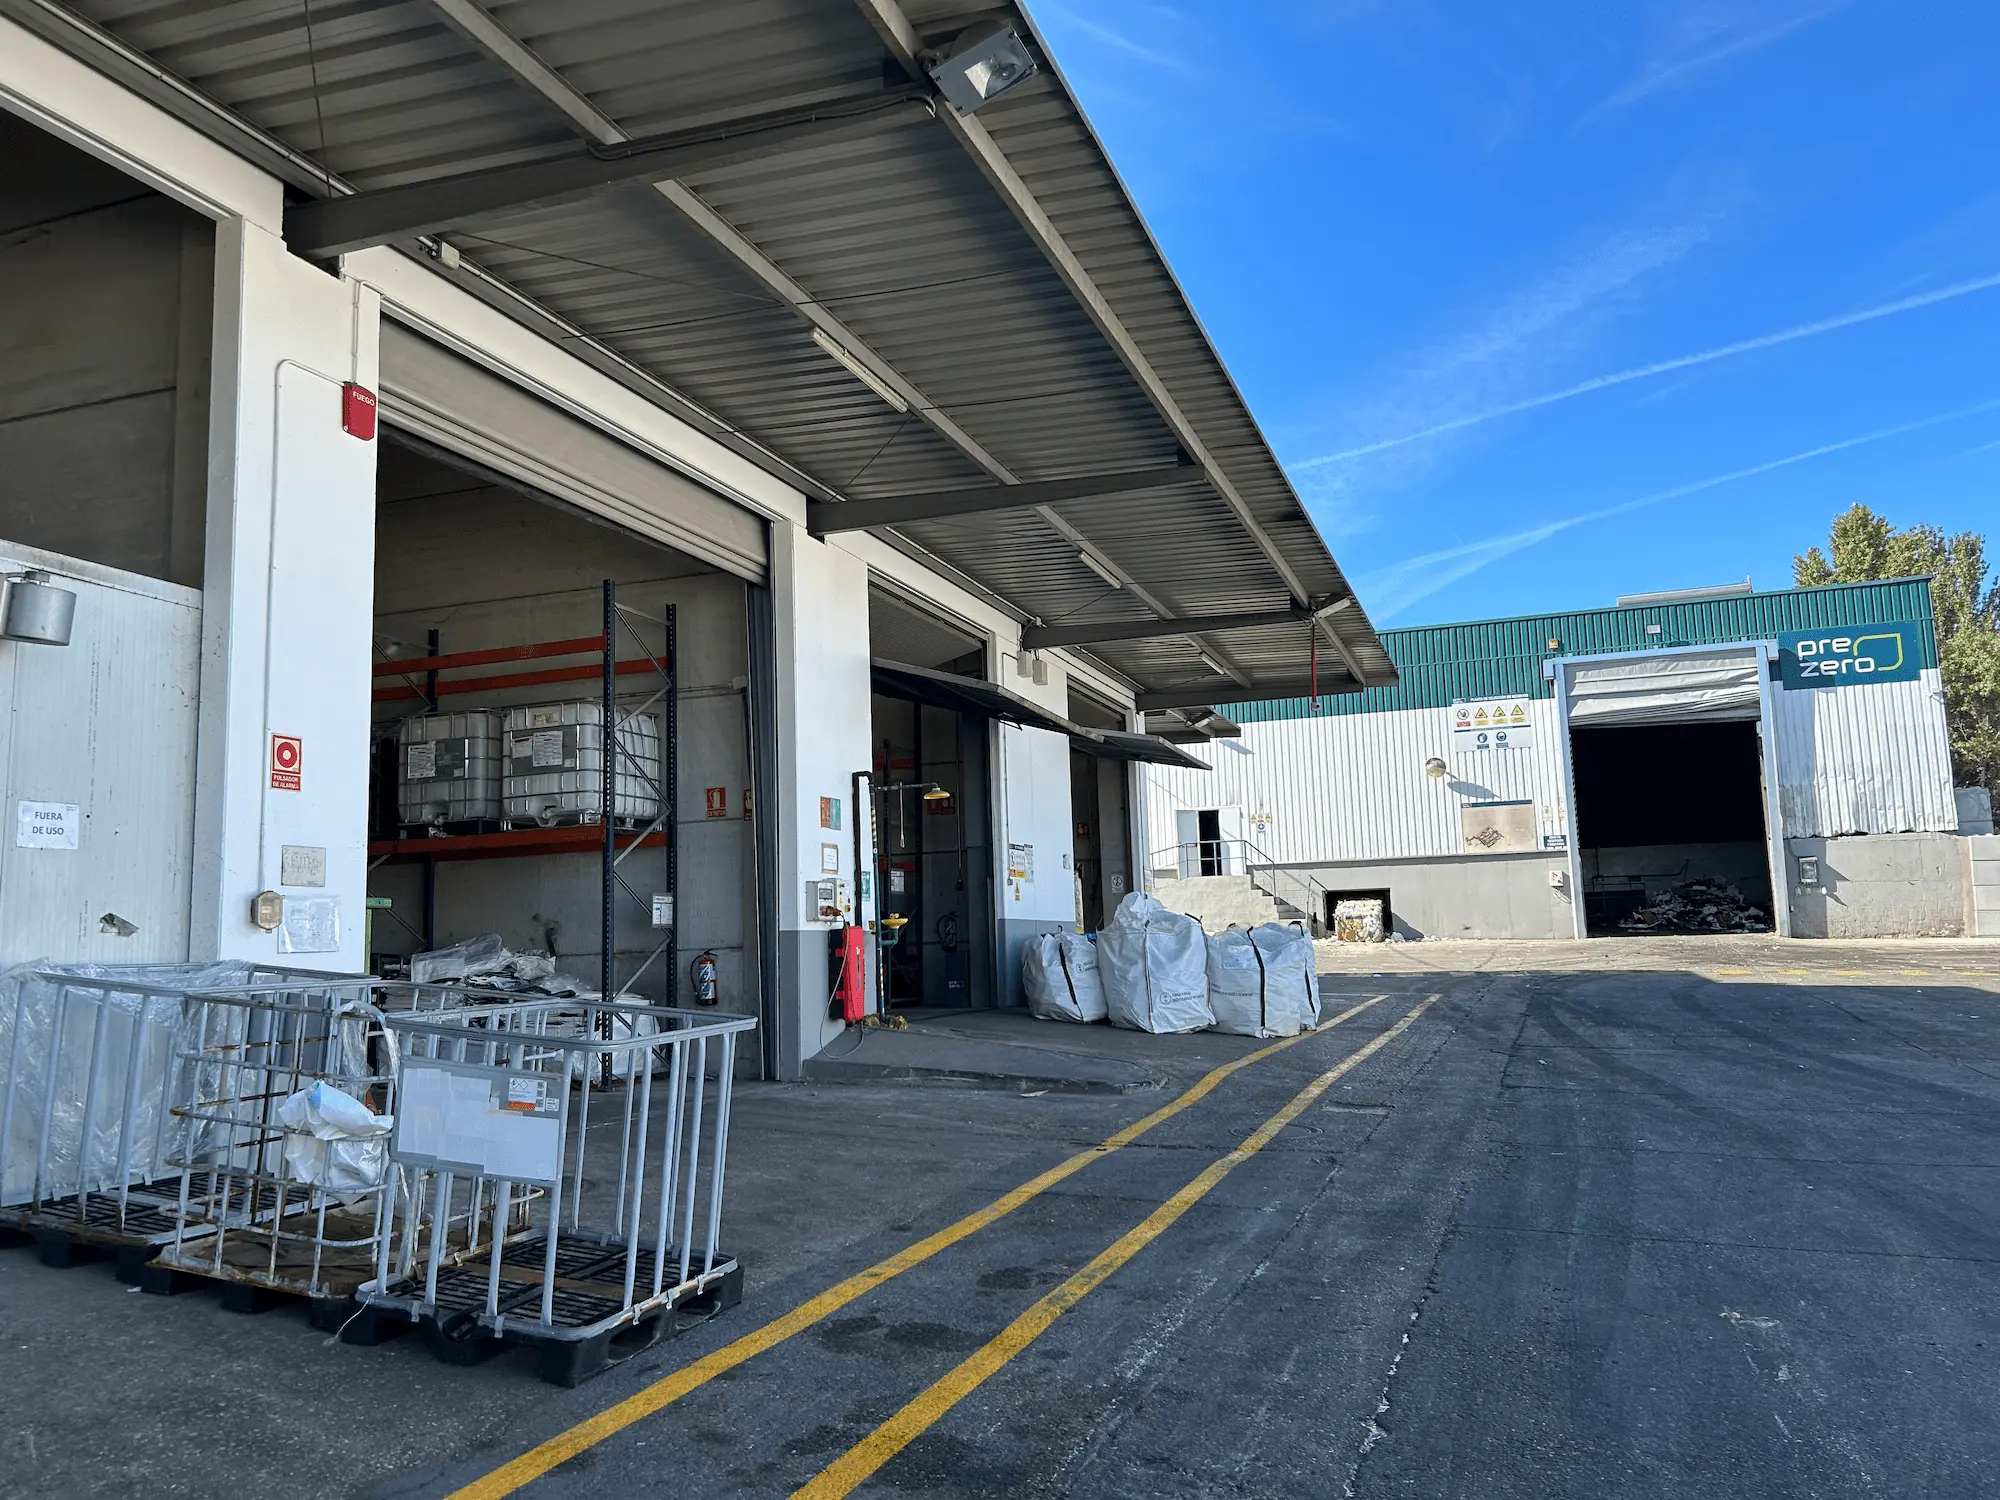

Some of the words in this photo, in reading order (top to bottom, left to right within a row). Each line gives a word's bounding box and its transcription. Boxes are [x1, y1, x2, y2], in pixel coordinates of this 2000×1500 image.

[353, 391, 375, 406] FUEGO
[1797, 637, 1851, 660] pre
[1800, 657, 1875, 677] zero
[35, 811, 62, 820] FUERA
[32, 826, 44, 834] DE
[46, 826, 64, 835] USO
